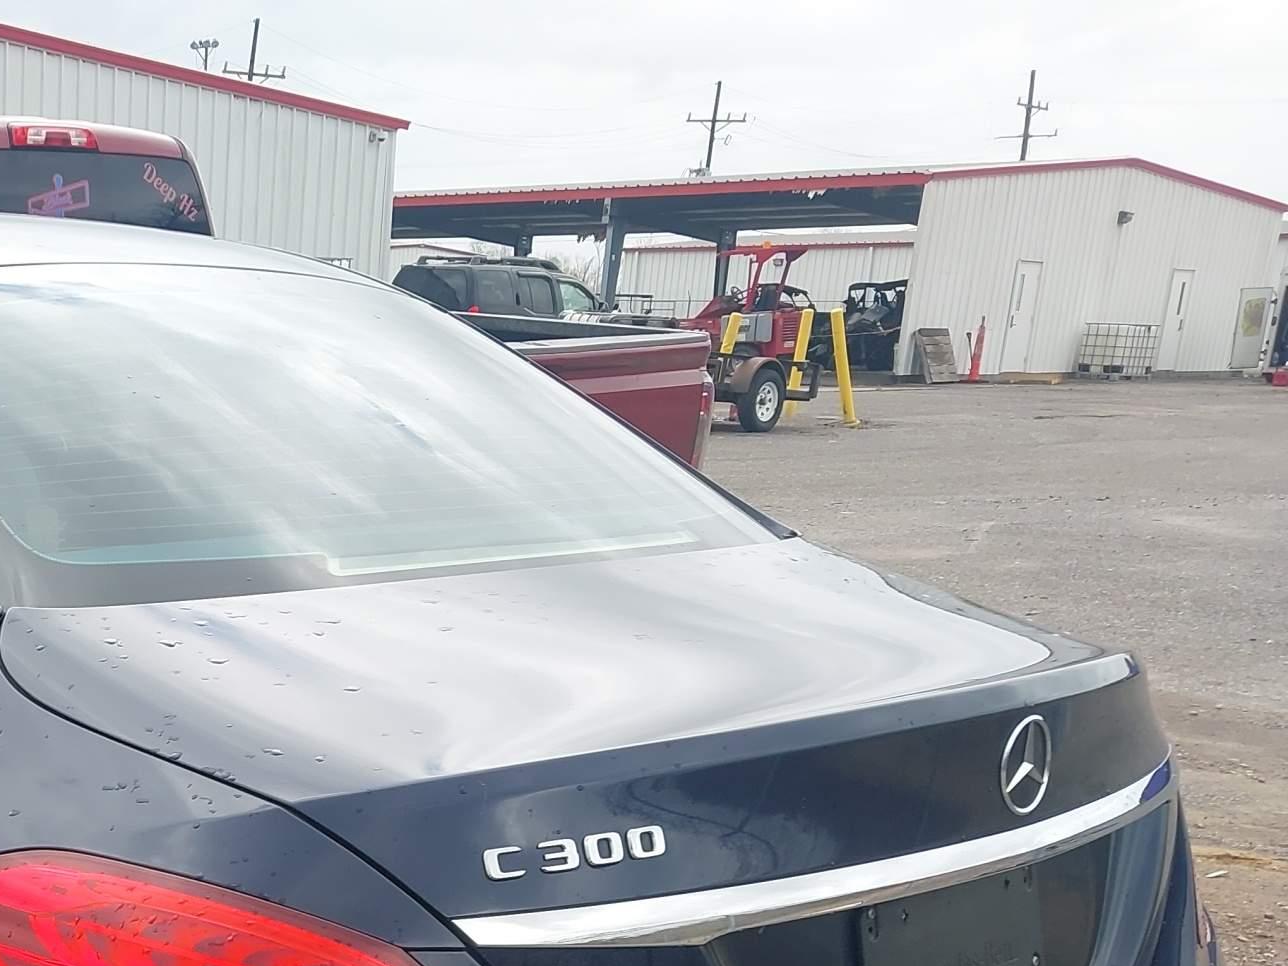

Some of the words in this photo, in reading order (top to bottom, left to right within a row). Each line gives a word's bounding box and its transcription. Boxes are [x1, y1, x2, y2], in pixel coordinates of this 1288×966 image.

[143, 162, 175, 203] Deep
[482, 845, 527, 881] C
[536, 824, 666, 873] 300
